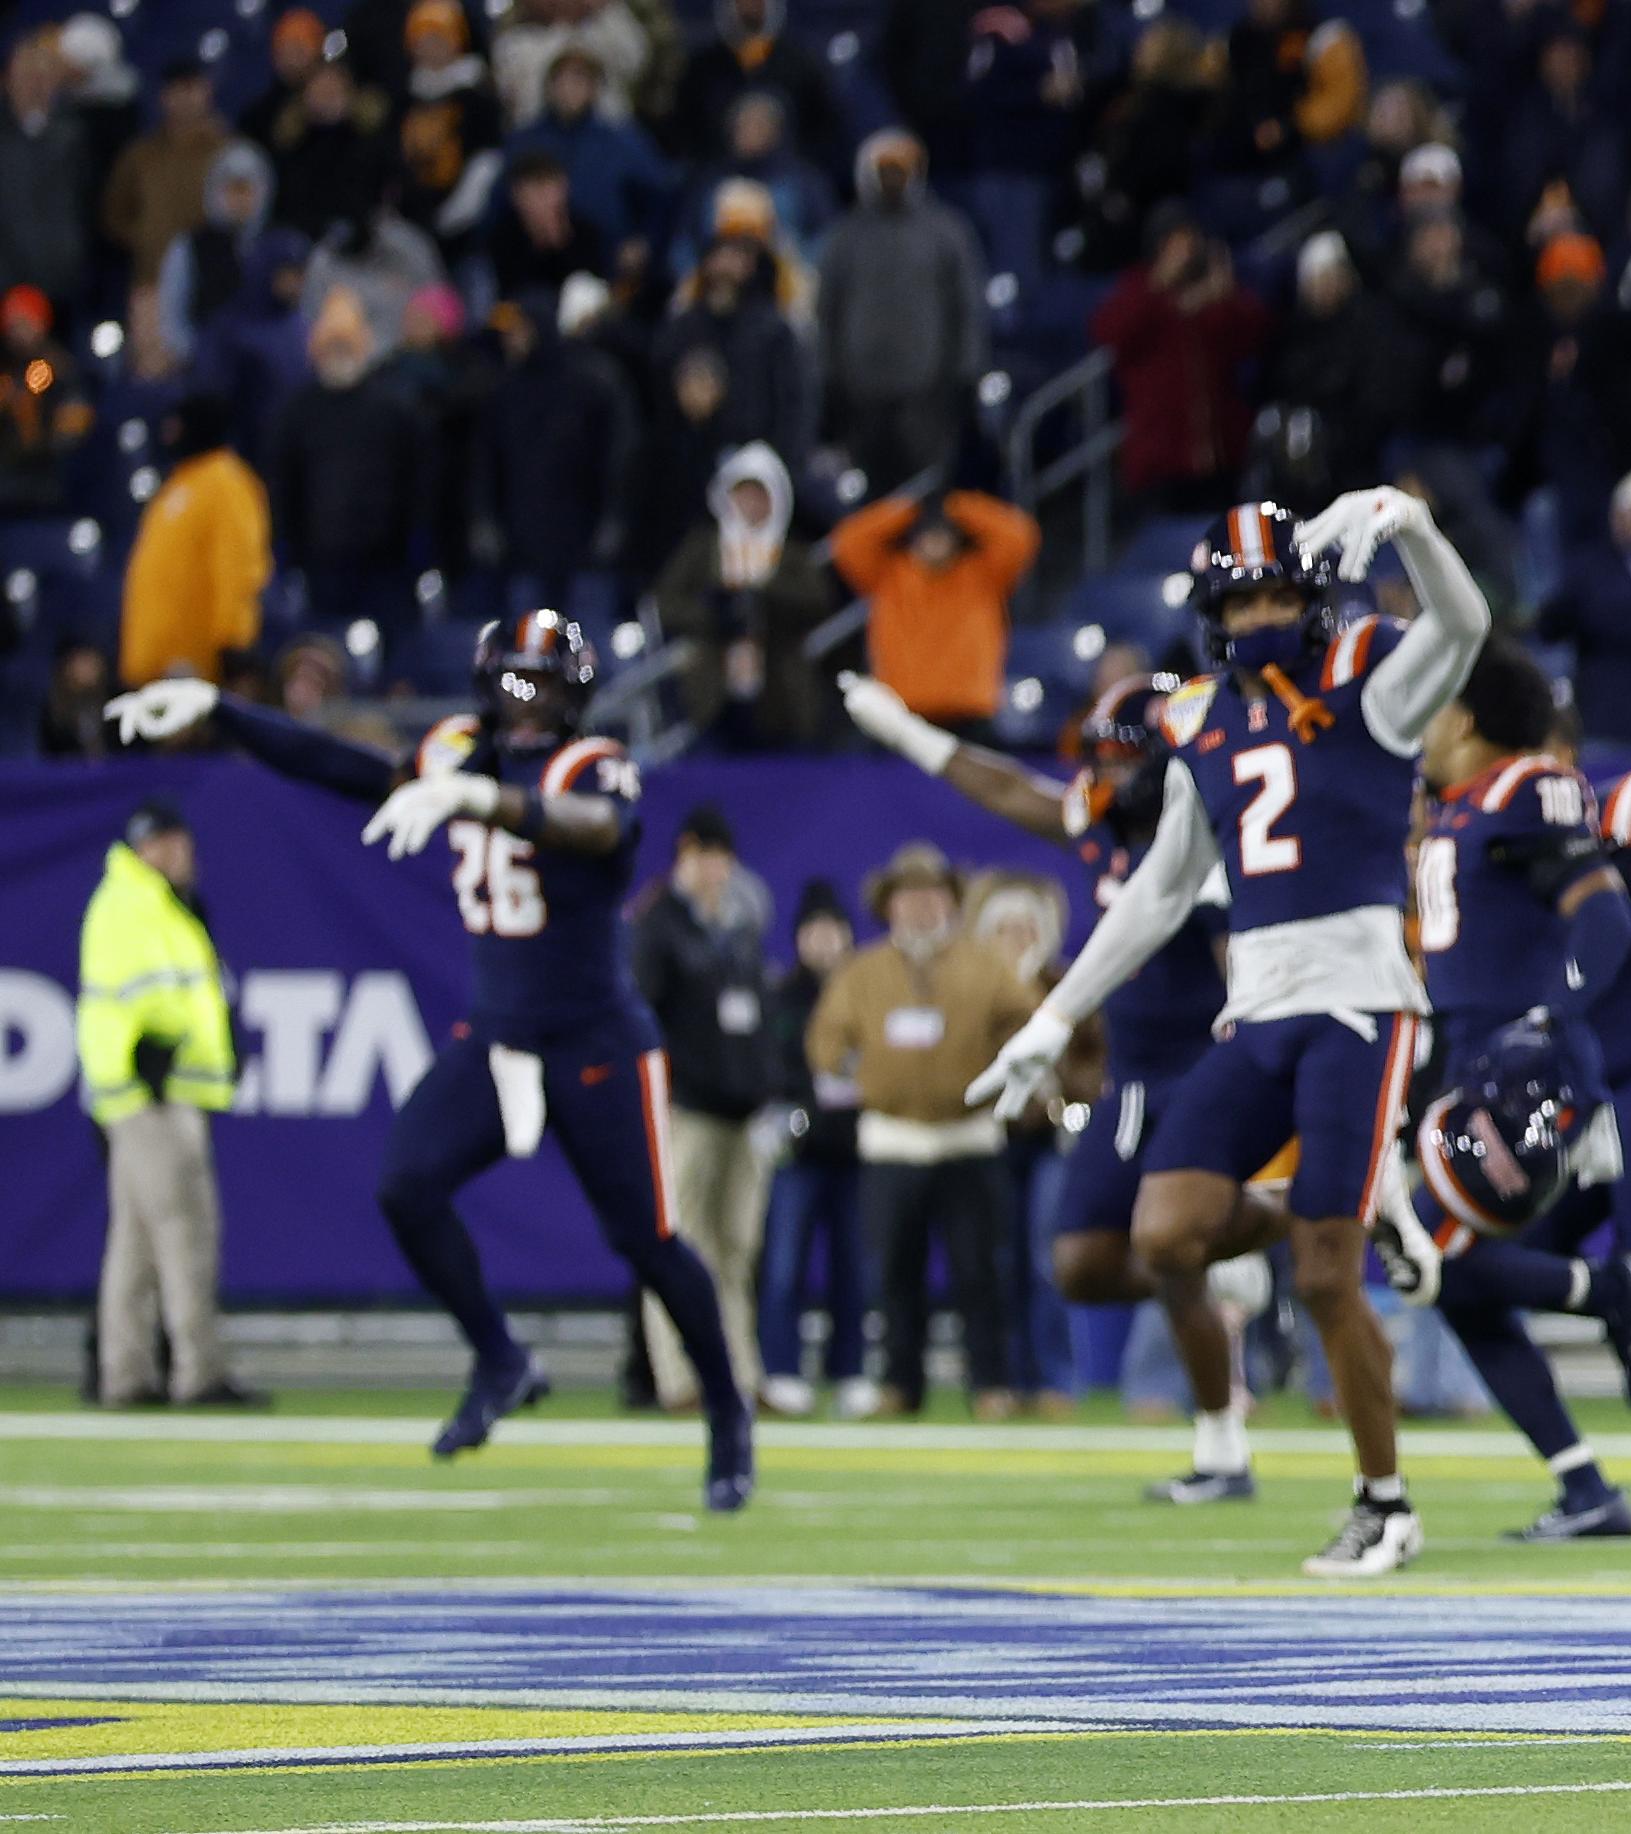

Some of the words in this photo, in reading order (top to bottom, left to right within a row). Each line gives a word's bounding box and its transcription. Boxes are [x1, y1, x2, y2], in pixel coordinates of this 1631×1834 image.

[447, 815, 550, 940] 26
[1231, 740, 1303, 878] 2
[0, 966, 438, 1117] DTA
